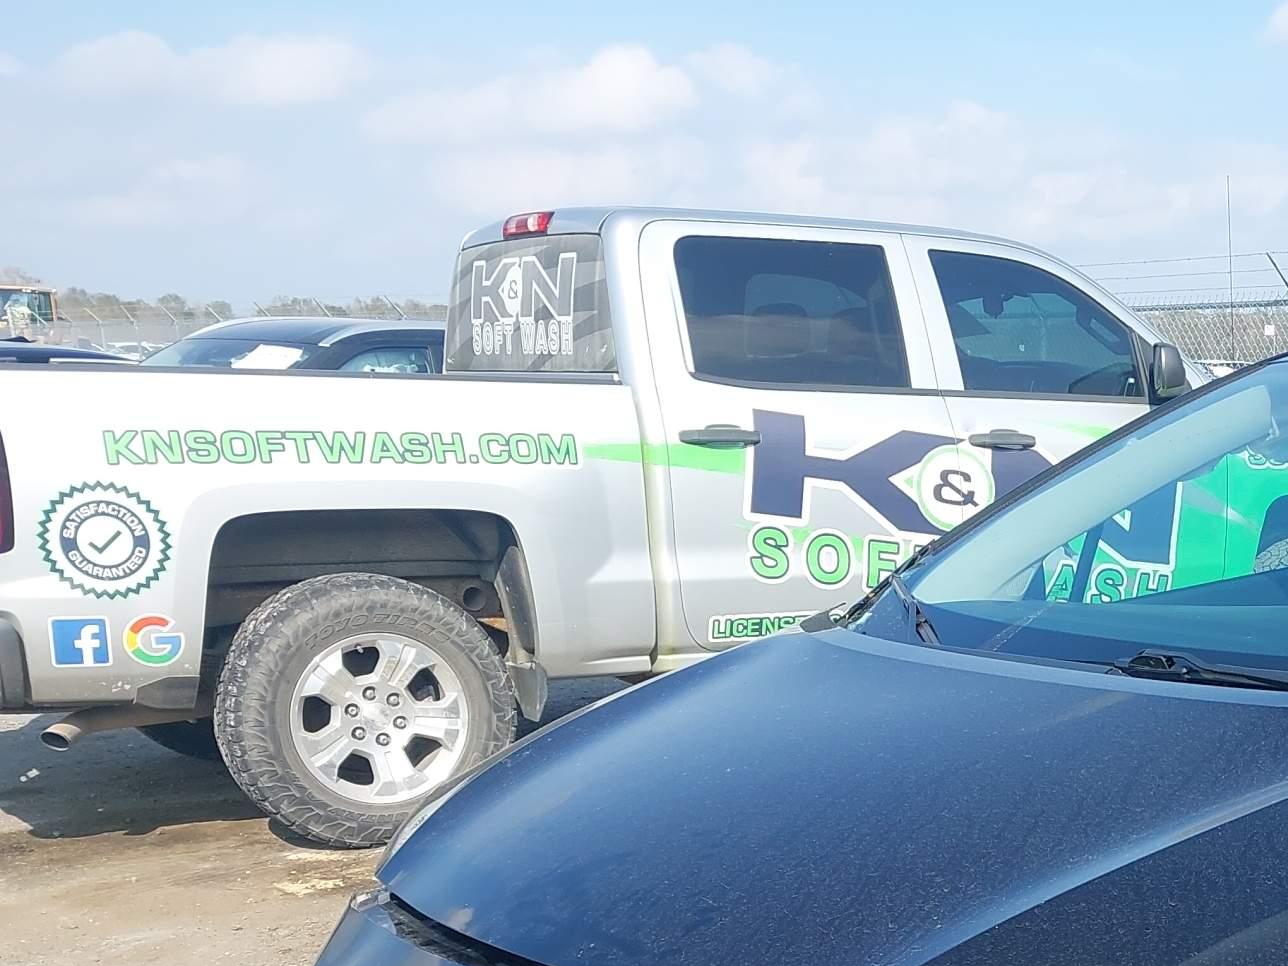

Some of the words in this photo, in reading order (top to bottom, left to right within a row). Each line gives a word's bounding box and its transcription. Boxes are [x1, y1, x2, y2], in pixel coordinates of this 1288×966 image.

[473, 322, 513, 355] SOFT
[519, 319, 574, 355] WASH
[102, 430, 579, 465] KNSOFTWASH.COM
[62, 502, 145, 540] SATISFACTION
[67, 546, 147, 578] GUARANTEED
